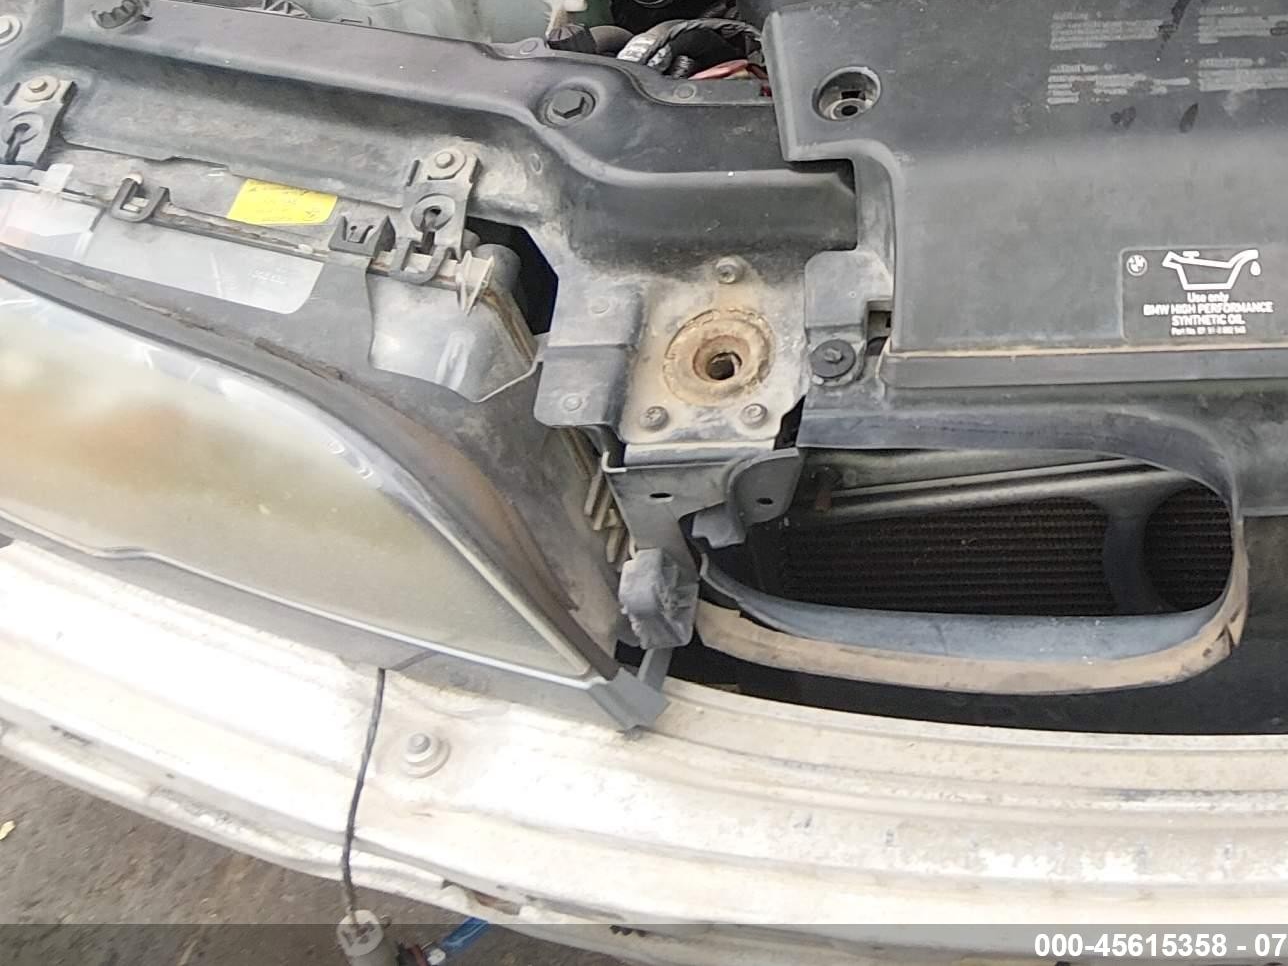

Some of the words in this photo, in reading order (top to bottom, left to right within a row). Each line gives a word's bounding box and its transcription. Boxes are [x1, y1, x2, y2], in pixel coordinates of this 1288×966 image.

[1143, 304, 1170, 316] BMW
[1171, 303, 1196, 315] HIGH
[1198, 301, 1274, 314] PERFORMANCE
[1172, 314, 1227, 326] SYNTHETIC
[1229, 314, 1245, 325] OIL
